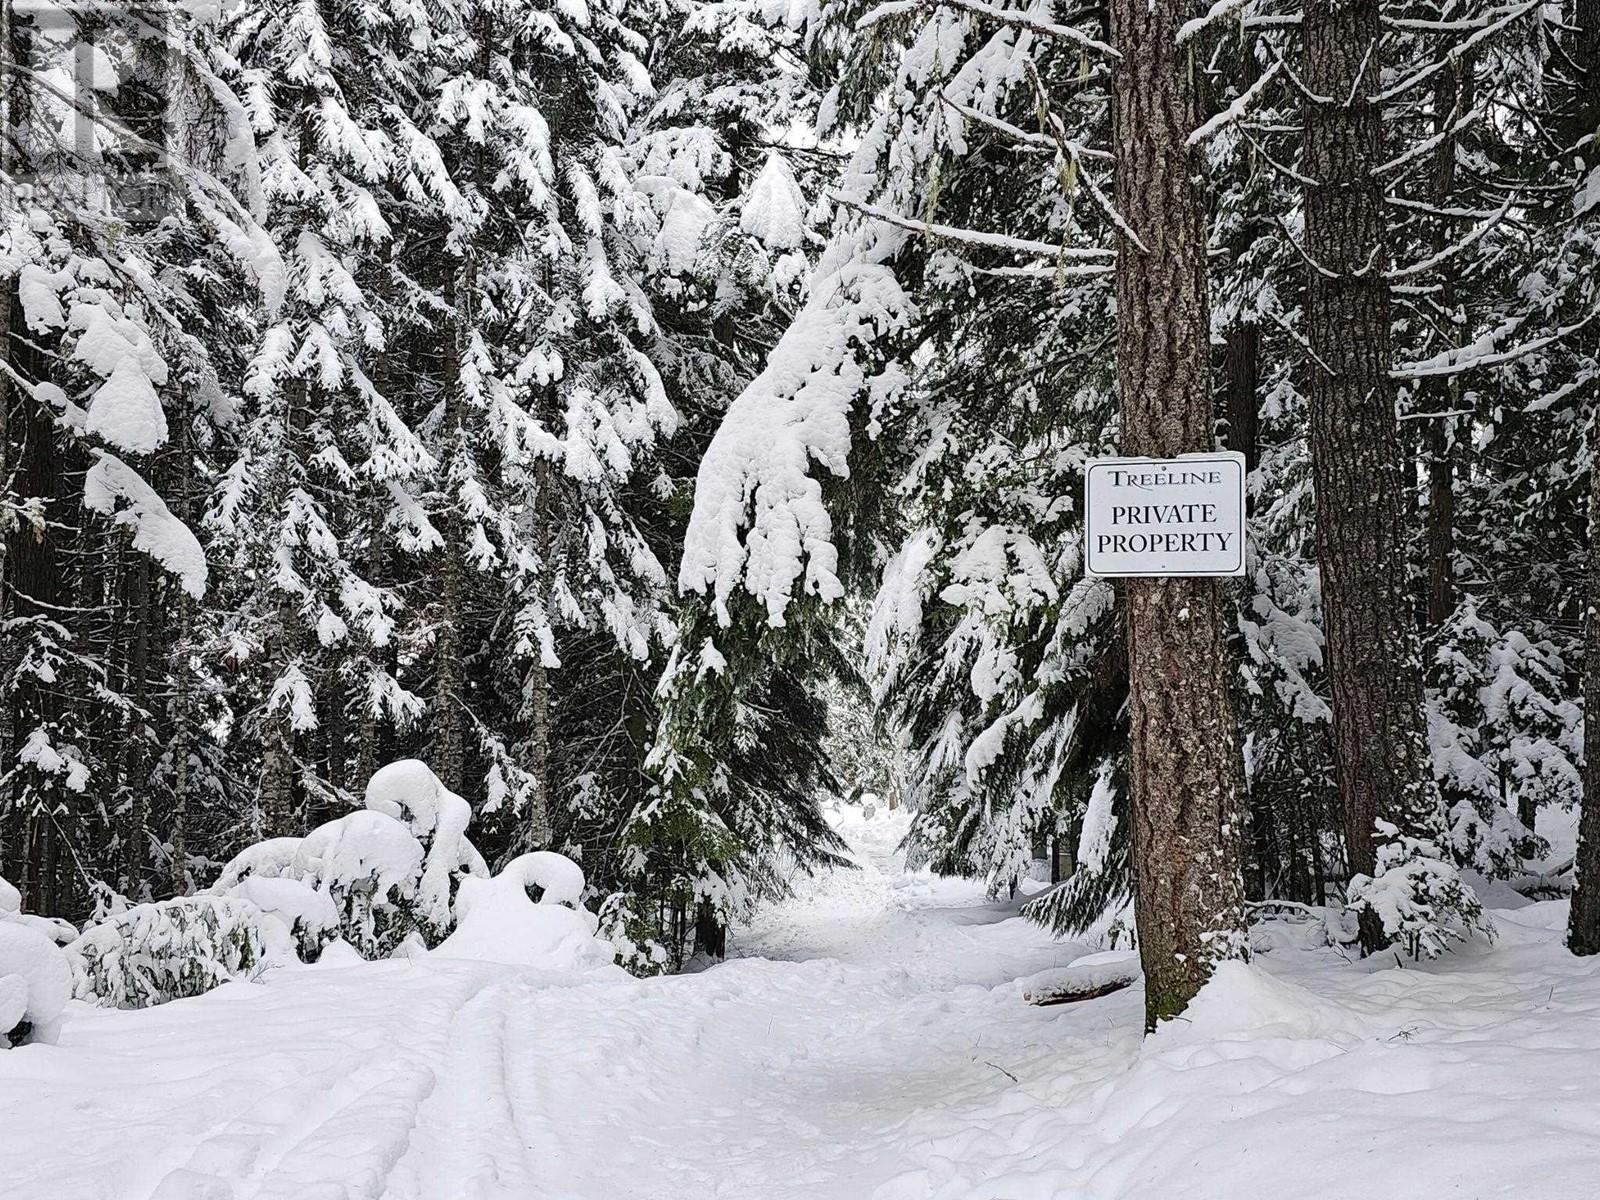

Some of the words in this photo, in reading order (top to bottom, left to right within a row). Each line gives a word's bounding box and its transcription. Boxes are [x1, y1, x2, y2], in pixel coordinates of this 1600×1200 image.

[1107, 470, 1222, 491] TREELINE
[1111, 503, 1217, 525] PRIVATE
[1097, 532, 1233, 554] PROPERTY
